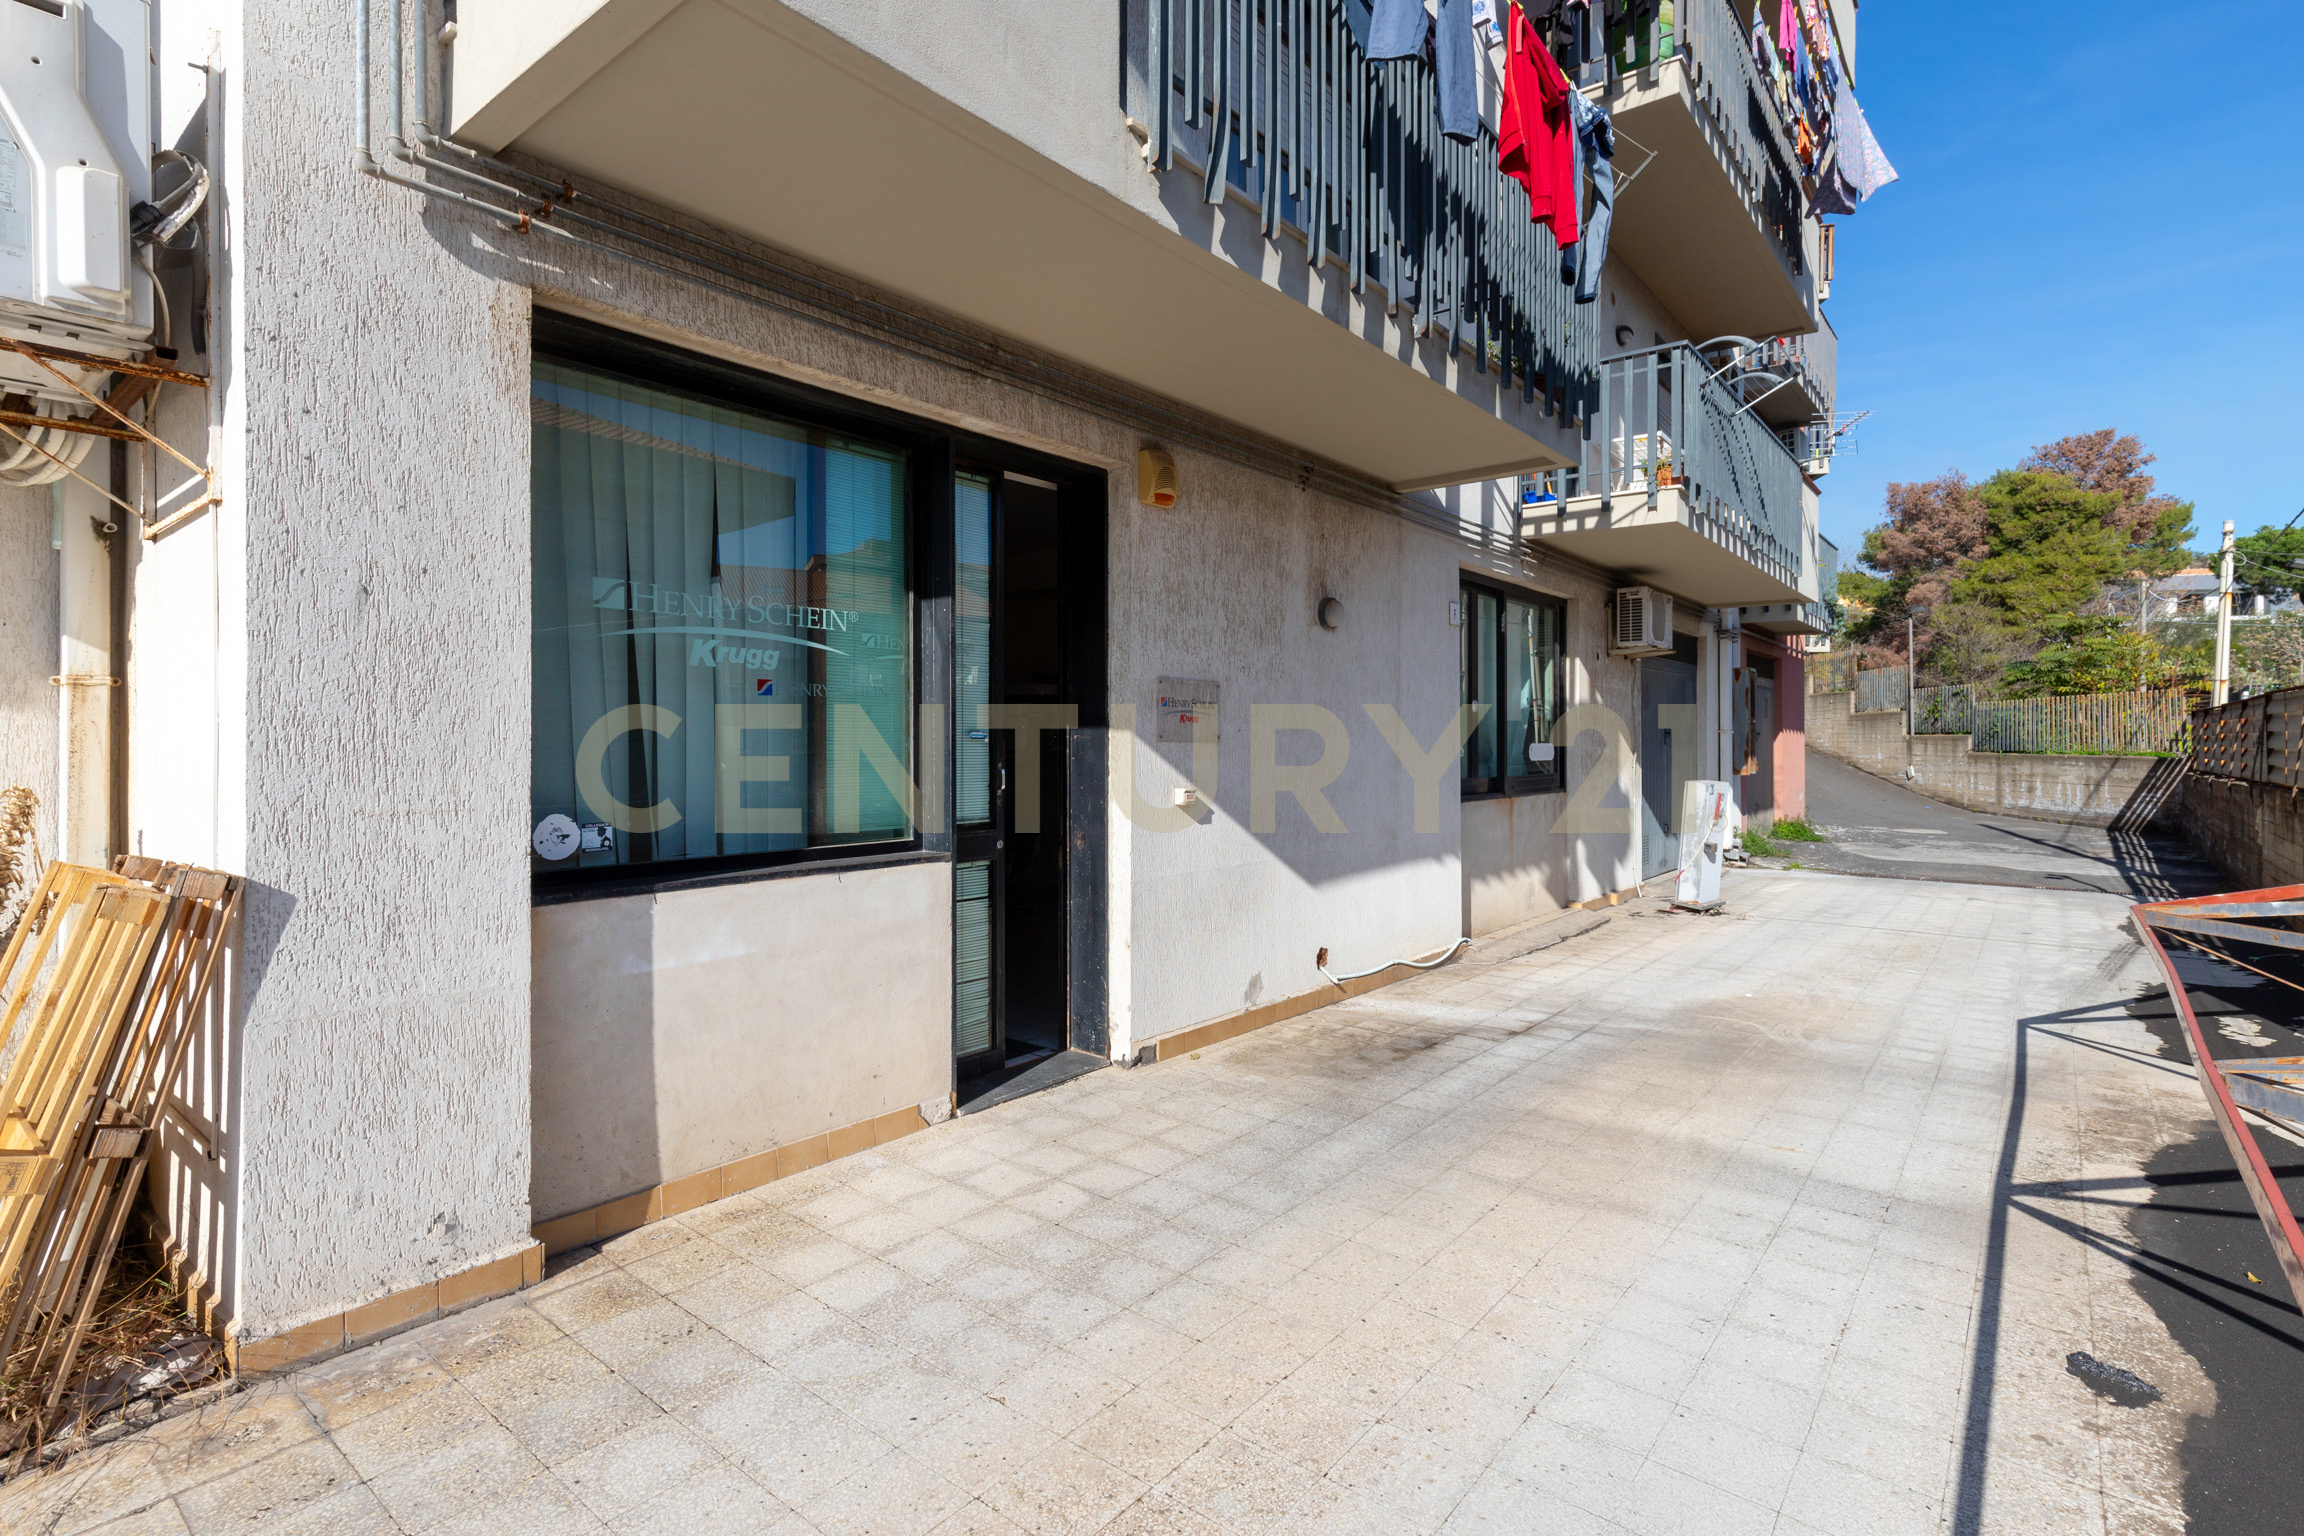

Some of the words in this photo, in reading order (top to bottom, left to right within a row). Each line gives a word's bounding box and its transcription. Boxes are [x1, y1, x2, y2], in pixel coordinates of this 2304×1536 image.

[628, 580, 742, 621] HENRY
[689, 638, 781, 671] Krugg
[1168, 697, 1190, 709] HENRY
